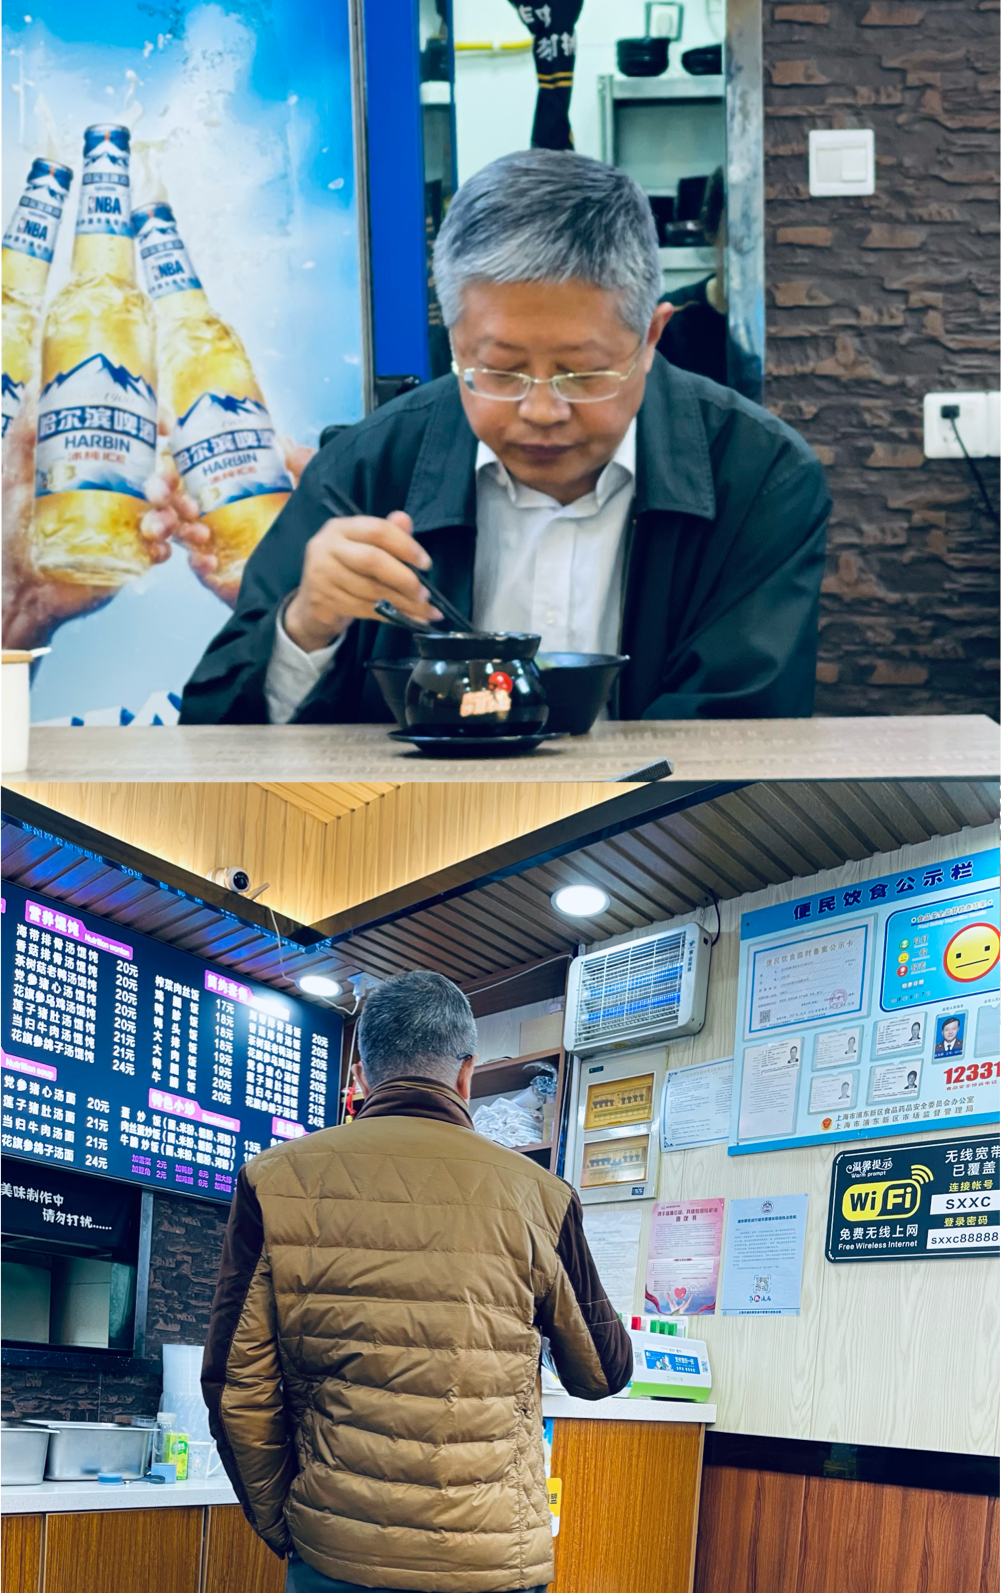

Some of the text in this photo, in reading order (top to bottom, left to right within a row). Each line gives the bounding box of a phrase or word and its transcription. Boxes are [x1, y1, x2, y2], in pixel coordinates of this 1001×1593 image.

[95, 195, 122, 215] NBA
[24, 219, 49, 241] NBA
[158, 259, 185, 278] NBA
[64, 434, 131, 454] HARBIN
[202, 452, 258, 477] HARBIN
[793, 861, 973, 921] 便民饮食公示栏
[116, 960, 139, 977] 20元
[115, 974, 138, 992] 20元
[115, 989, 138, 1006] 20元
[114, 1003, 137, 1020] 20元
[215, 998, 235, 1015] 17元
[114, 1017, 137, 1034] 20元
[113, 1031, 136, 1048] 21元
[113, 1045, 136, 1062] 21元
[112, 1059, 136, 1076] 24元
[212, 1077, 232, 1092] 20元
[87, 1097, 110, 1114] 20元
[211, 1090, 232, 1105] 20元
[86, 1116, 109, 1133] 21元
[85, 1135, 109, 1151] 21元
[85, 1154, 108, 1170] 24元
[952, 1161, 997, 1177] 已覆盖
[0, 1182, 65, 1208] 美味制作中
[944, 1215, 989, 1227] 登录密码
[839, 1224, 919, 1241] 免费无线上网
[855, 1241, 887, 1250] Wireless
[888, 1240, 918, 1249] Internet
